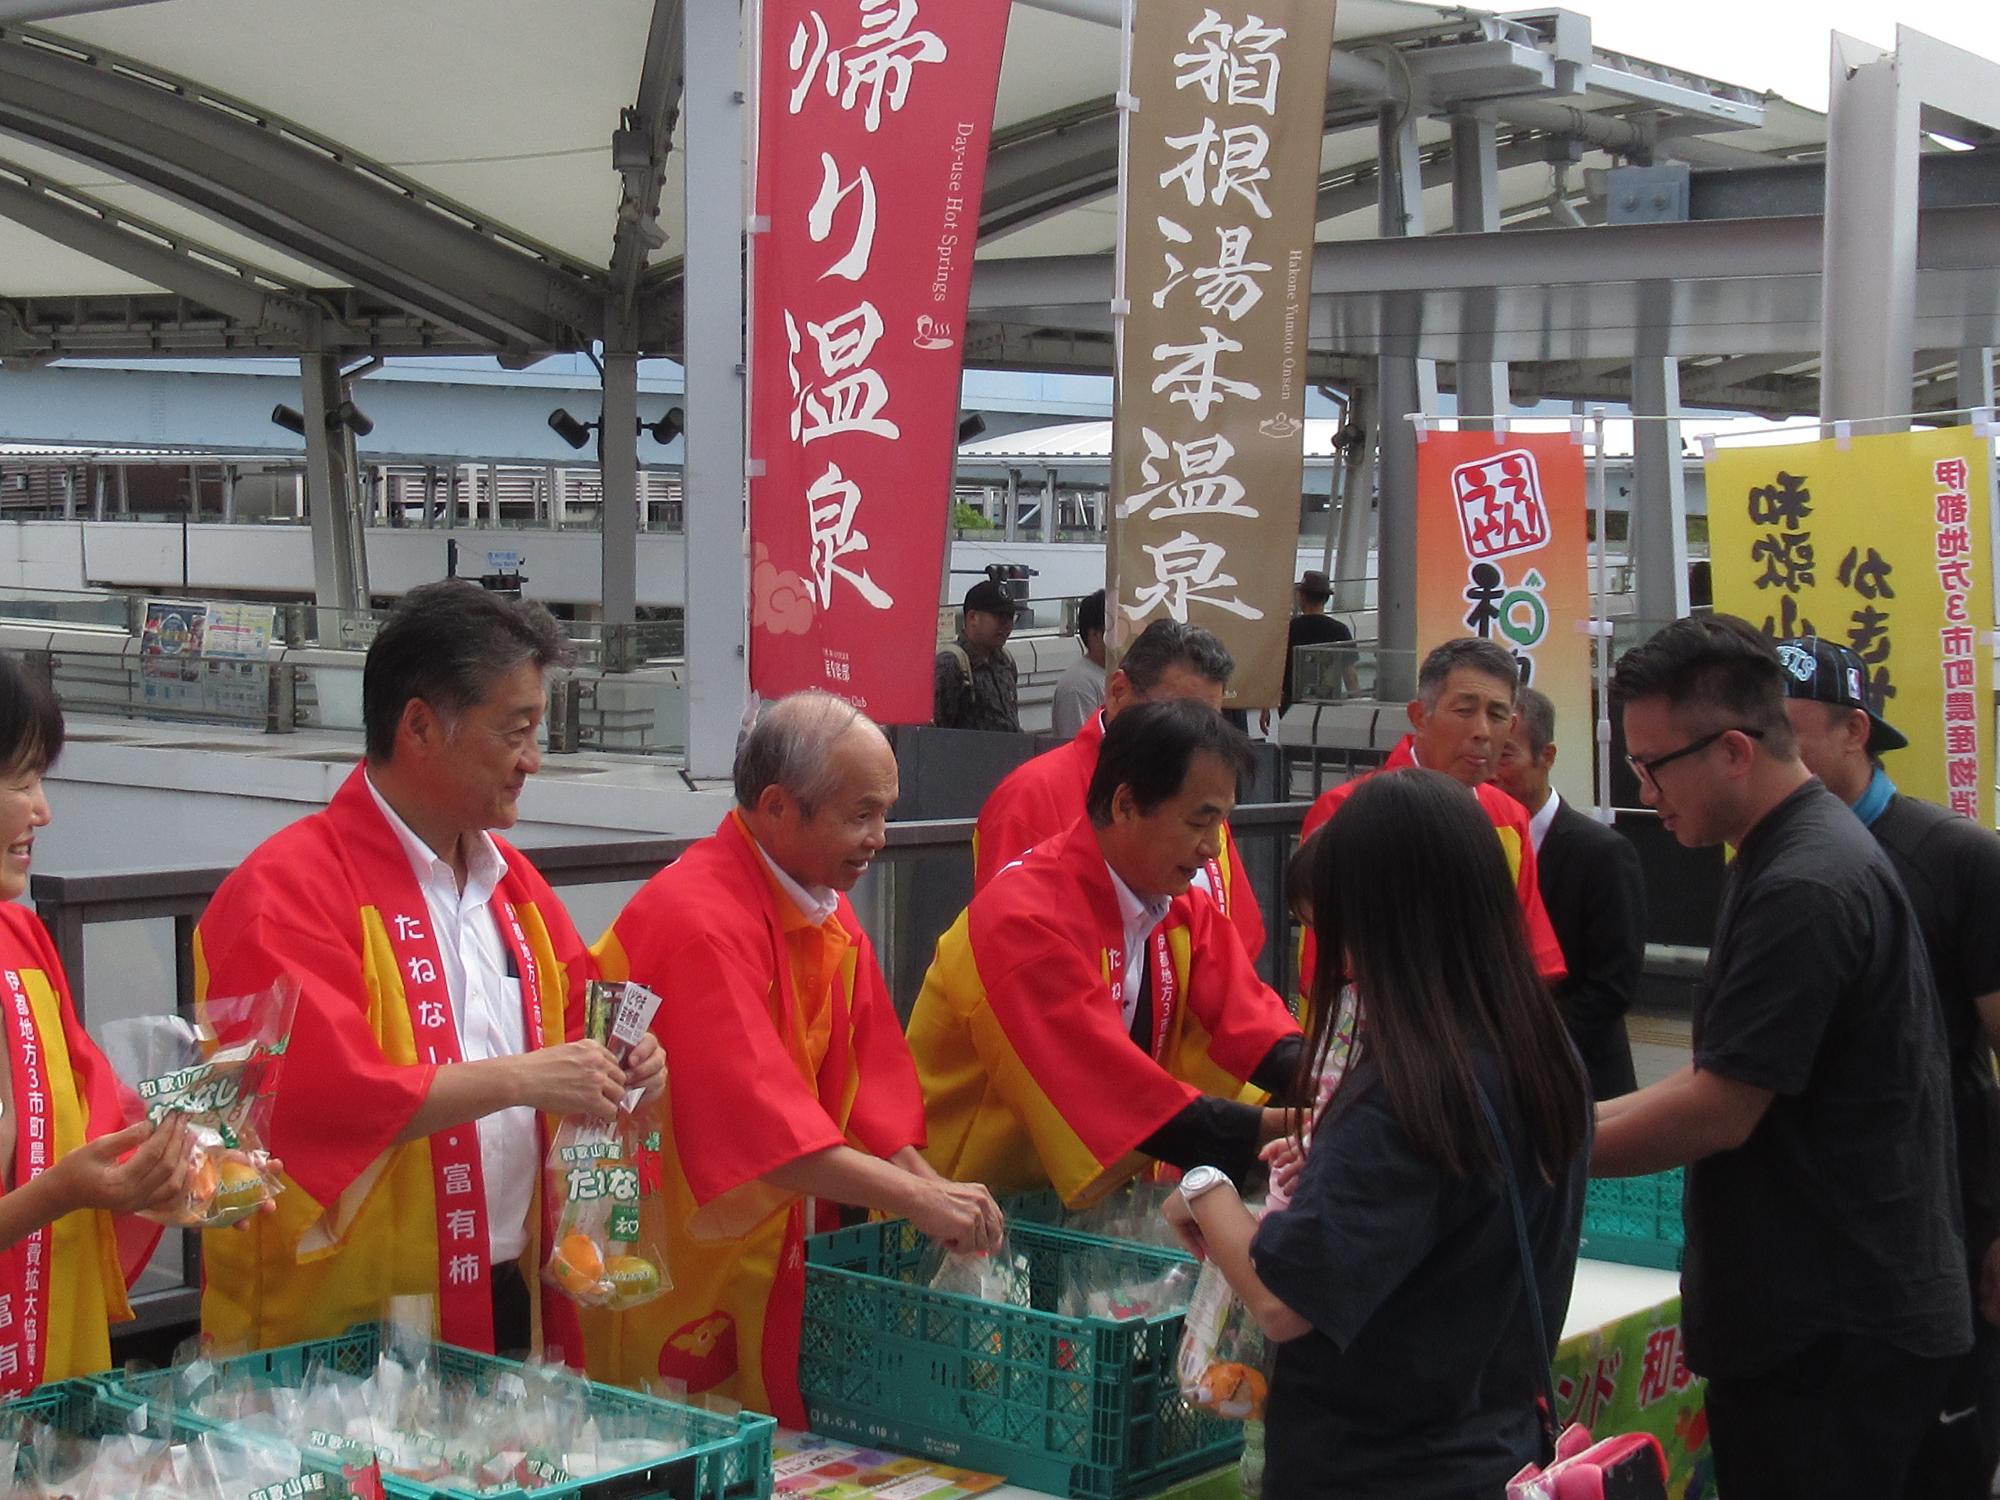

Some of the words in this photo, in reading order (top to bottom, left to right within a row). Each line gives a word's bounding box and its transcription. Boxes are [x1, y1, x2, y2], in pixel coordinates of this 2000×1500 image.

[951, 121, 975, 192] Day-use
[943, 198, 964, 229] Hot
[931, 234, 959, 302] Springs
[1286, 250, 1303, 300] Hakone
[1121, 8, 1288, 622] 箱根湯本温泉
[1284, 304, 1300, 354] Yumoto
[1281, 358, 1297, 400] Onsen
